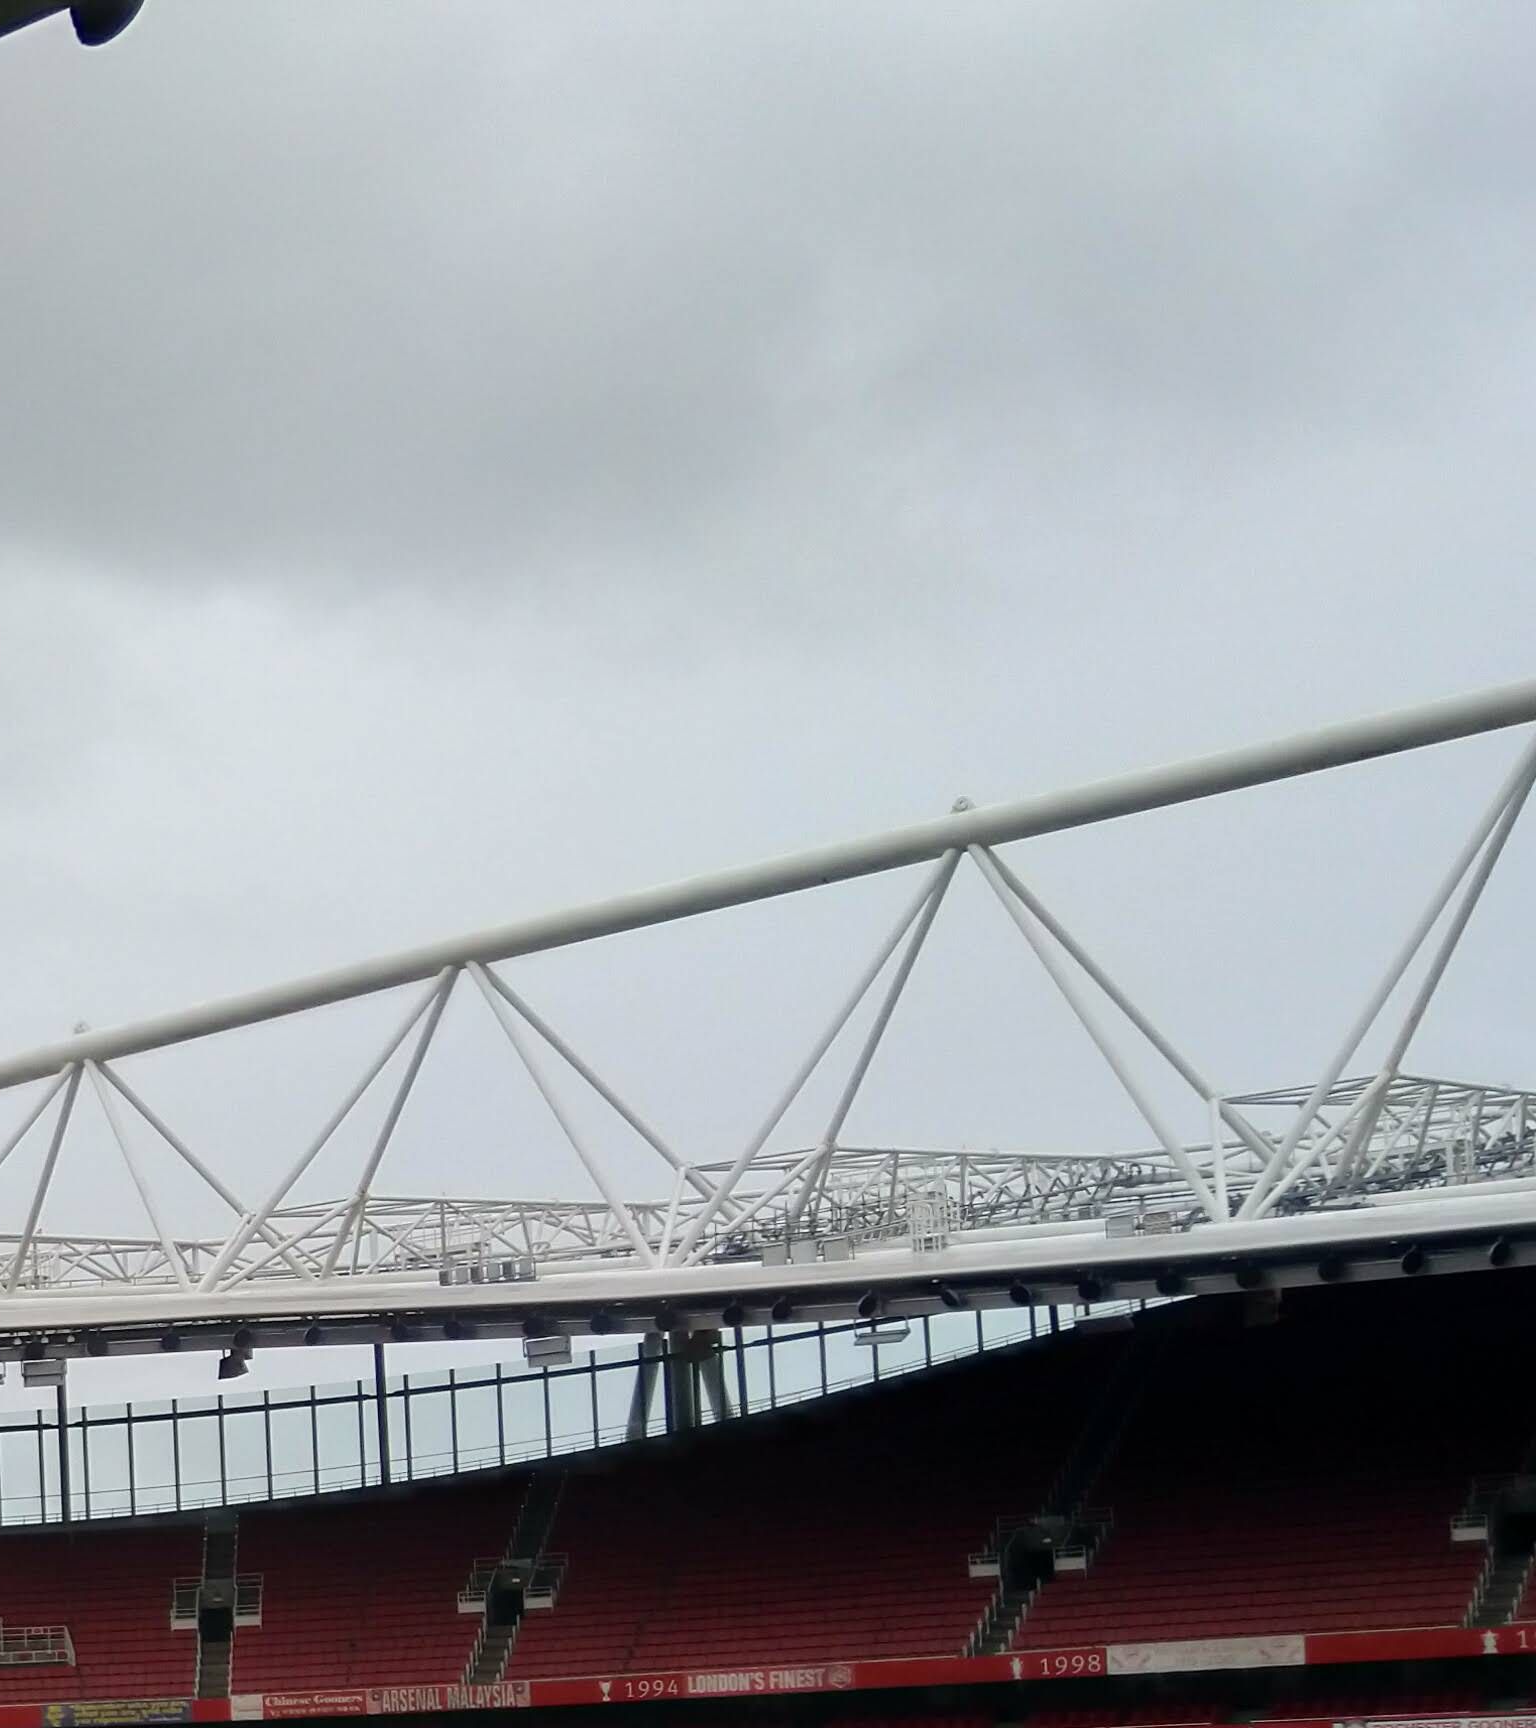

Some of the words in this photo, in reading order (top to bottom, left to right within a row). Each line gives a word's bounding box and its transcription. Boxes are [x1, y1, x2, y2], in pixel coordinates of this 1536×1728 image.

[1040, 1654, 1101, 1674] 1998
[625, 1680, 678, 1698] 1994
[688, 1672, 764, 1693] LONDON'S
[769, 1669, 826, 1690] FINEST
[382, 1689, 442, 1711] ARSENAL
[447, 1684, 516, 1709] MALAYSIA
